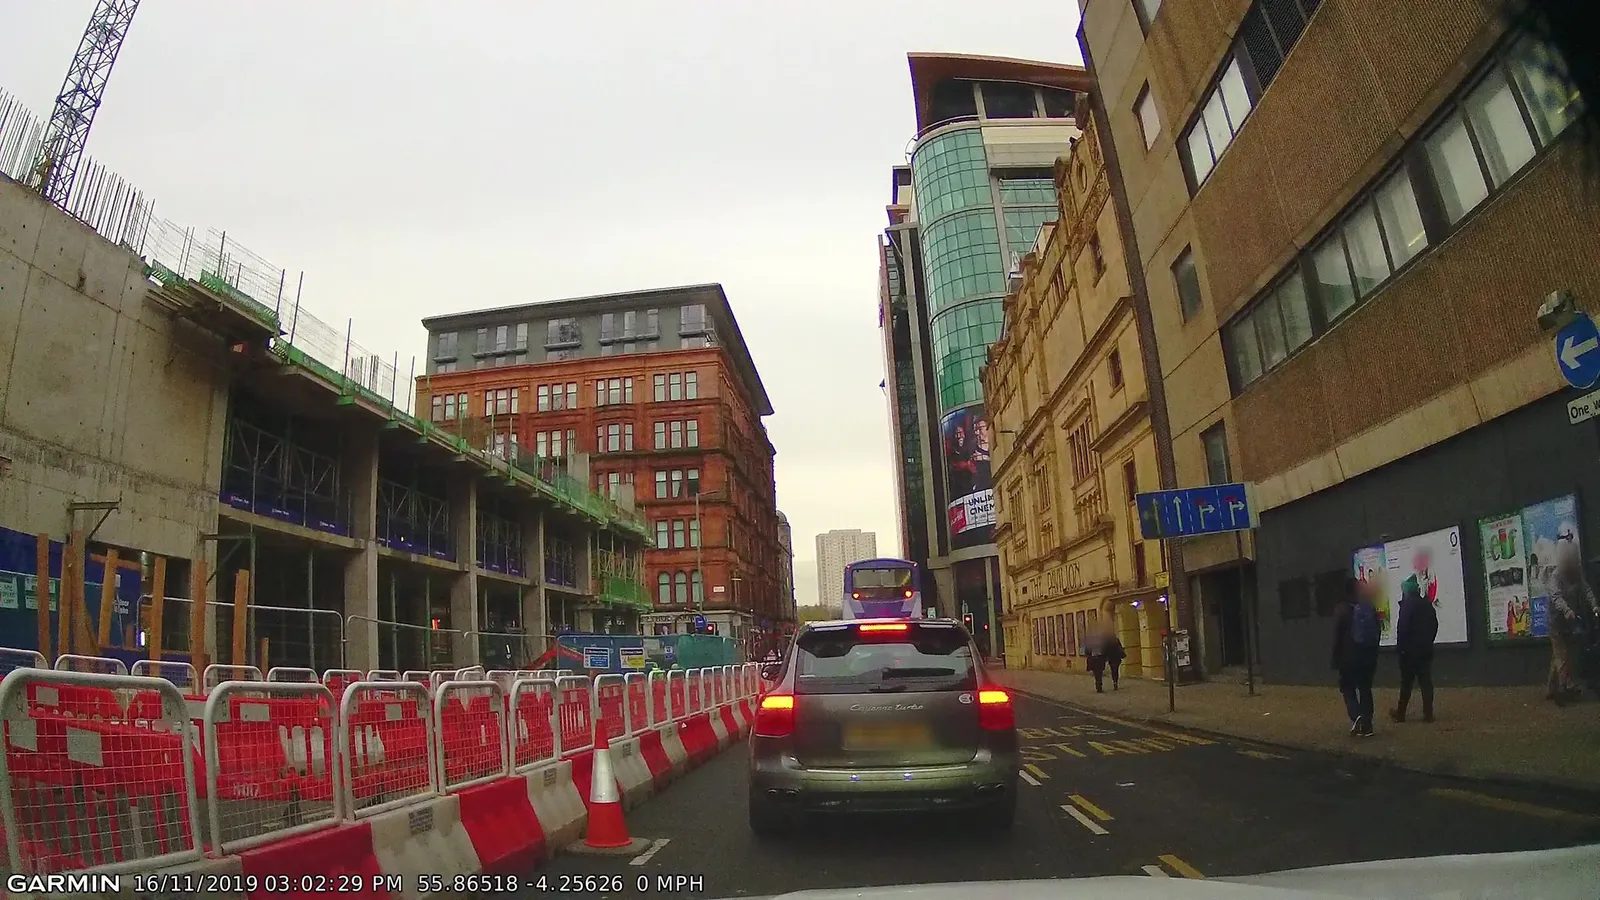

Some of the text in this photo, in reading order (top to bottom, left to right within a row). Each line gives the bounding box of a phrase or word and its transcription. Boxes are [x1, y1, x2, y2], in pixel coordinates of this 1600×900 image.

[1570, 404, 1590, 419] One
[894, 703, 924, 711] turbo
[1015, 724, 1117, 740] BUS
